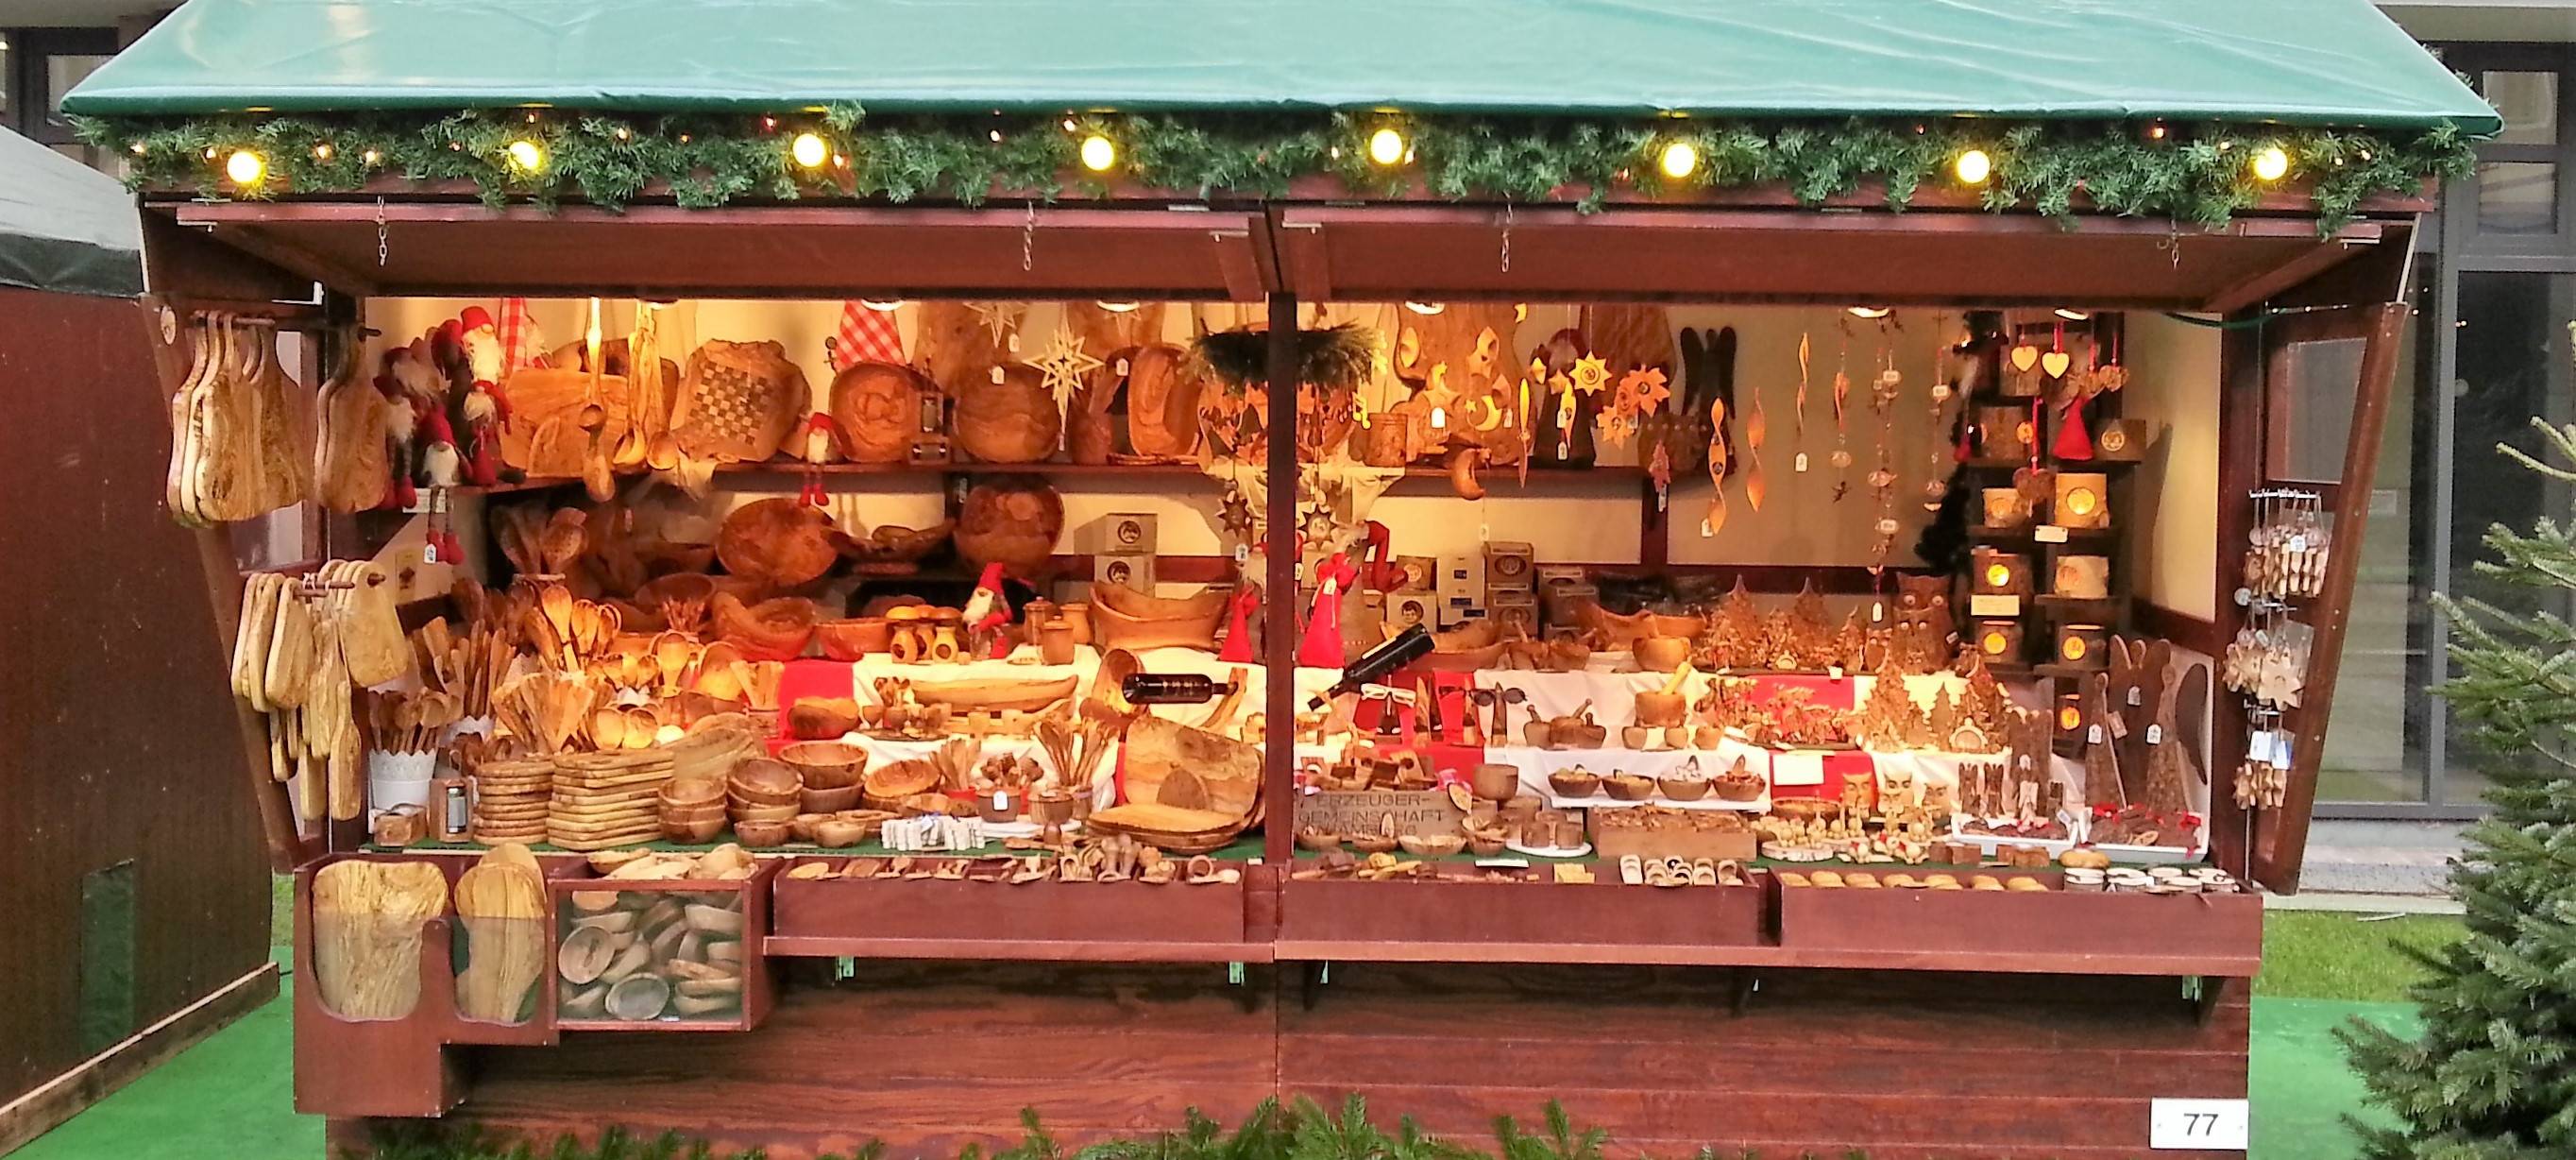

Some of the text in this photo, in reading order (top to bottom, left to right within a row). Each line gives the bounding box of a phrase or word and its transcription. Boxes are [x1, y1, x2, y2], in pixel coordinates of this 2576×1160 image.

[1316, 793, 1431, 808] ERZEUGER-
[1298, 809, 1445, 824] GEMEINSHAFT
[2183, 1112, 2219, 1136] 77
